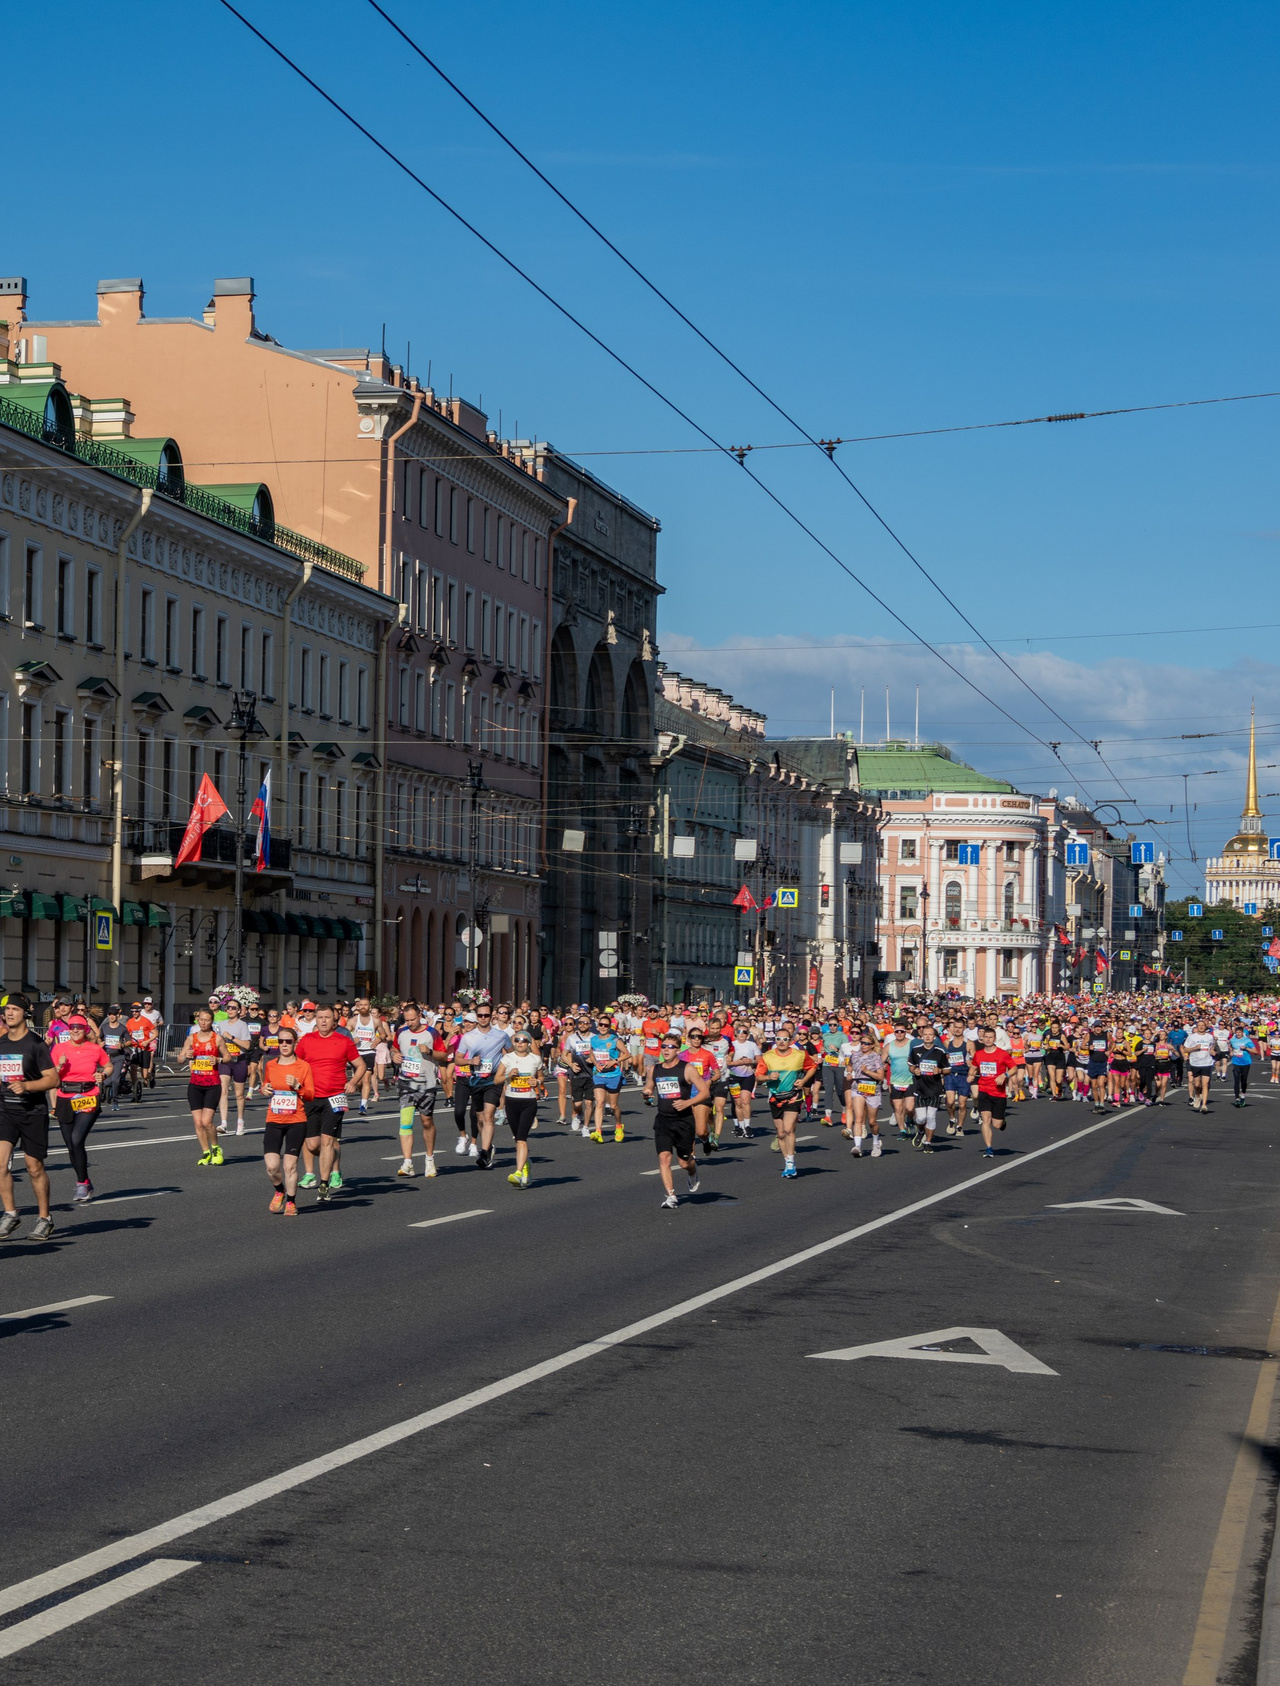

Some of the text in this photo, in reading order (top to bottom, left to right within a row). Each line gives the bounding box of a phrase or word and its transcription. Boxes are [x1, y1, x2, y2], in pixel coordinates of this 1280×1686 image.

[0, 1063, 21, 1073] 15307
[657, 1082, 679, 1091] 14190
[72, 1098, 95, 1108] 12941
[273, 1098, 296, 1107] 14924
